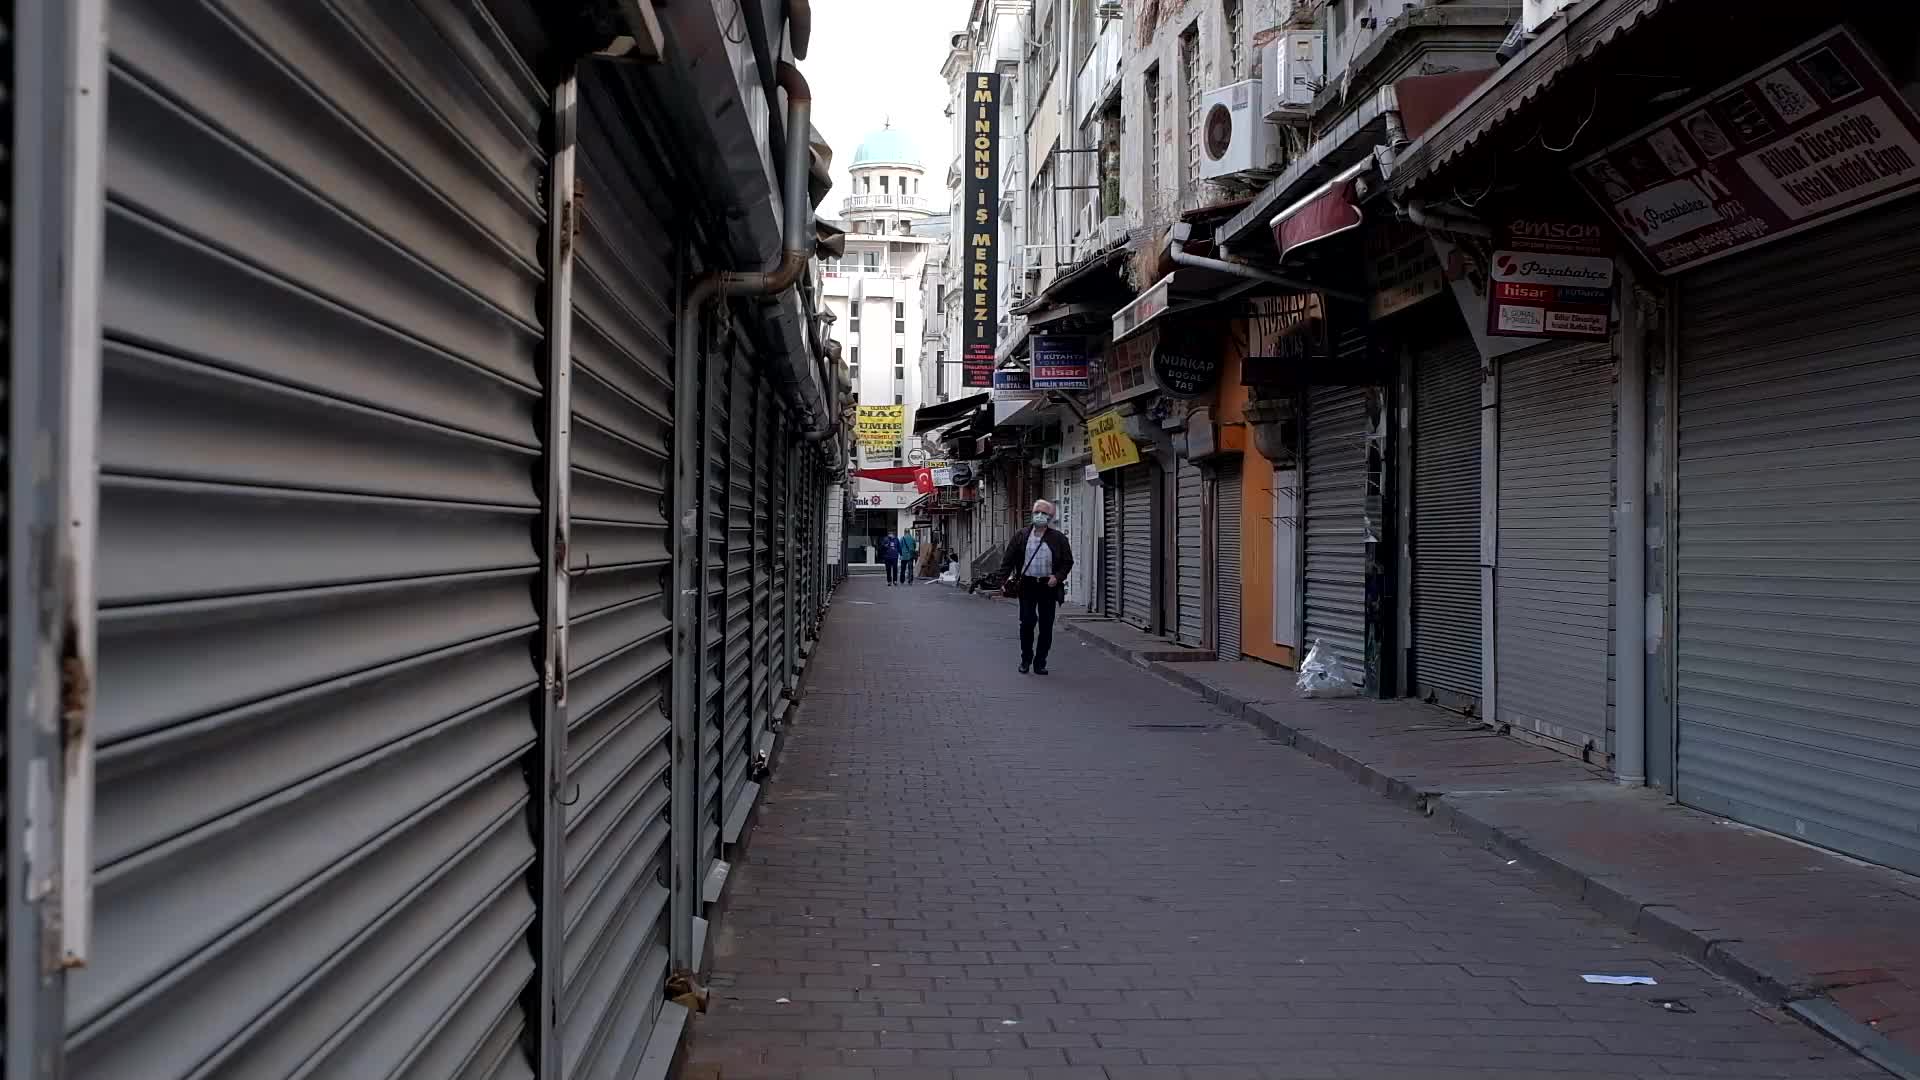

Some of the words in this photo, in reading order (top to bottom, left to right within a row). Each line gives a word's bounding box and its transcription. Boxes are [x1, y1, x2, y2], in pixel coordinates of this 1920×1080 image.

[974, 76, 992, 179] EMİNÖNÜ
[1757, 145, 1810, 179] Billur
[1794, 115, 1881, 163] Züccaciye
[1782, 169, 1837, 207] Kristal
[976, 189, 988, 224] İŞ
[972, 234, 991, 337] MERKEZİ
[1520, 261, 1607, 280] Paşabahçe
[1504, 283, 1548, 298] hisar
[1041, 367, 1082, 376] hisar
